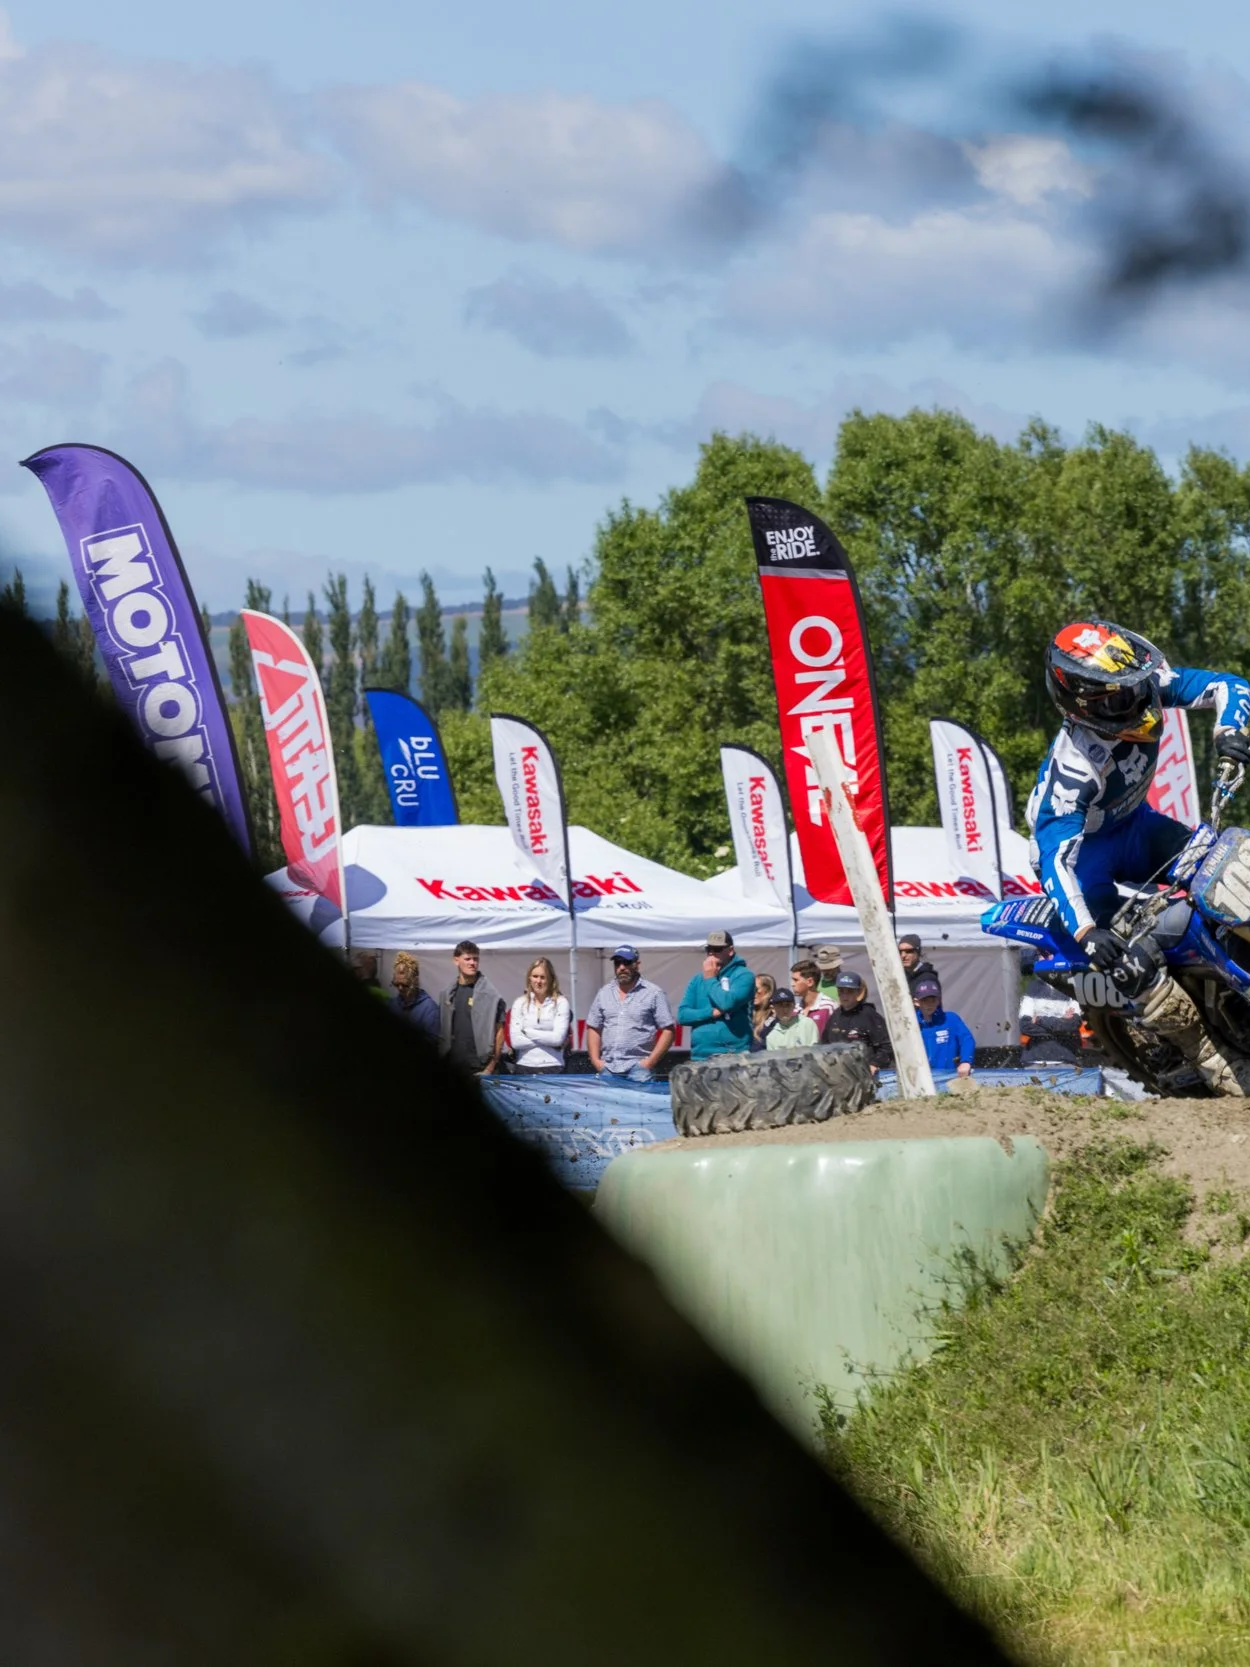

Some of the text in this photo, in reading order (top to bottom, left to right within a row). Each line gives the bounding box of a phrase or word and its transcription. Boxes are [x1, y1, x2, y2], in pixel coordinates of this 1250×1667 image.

[766, 525, 814, 546] ENJOY
[390, 764, 420, 807] CRU
[520, 746, 549, 855] Kawasaki
[949, 783, 957, 808] Good
[956, 747, 983, 853] Kawasaki
[1202, 843, 1230, 878] YAMAHA
[618, 899, 654, 910] Roll
[1016, 929, 1044, 941] DUNLOP
